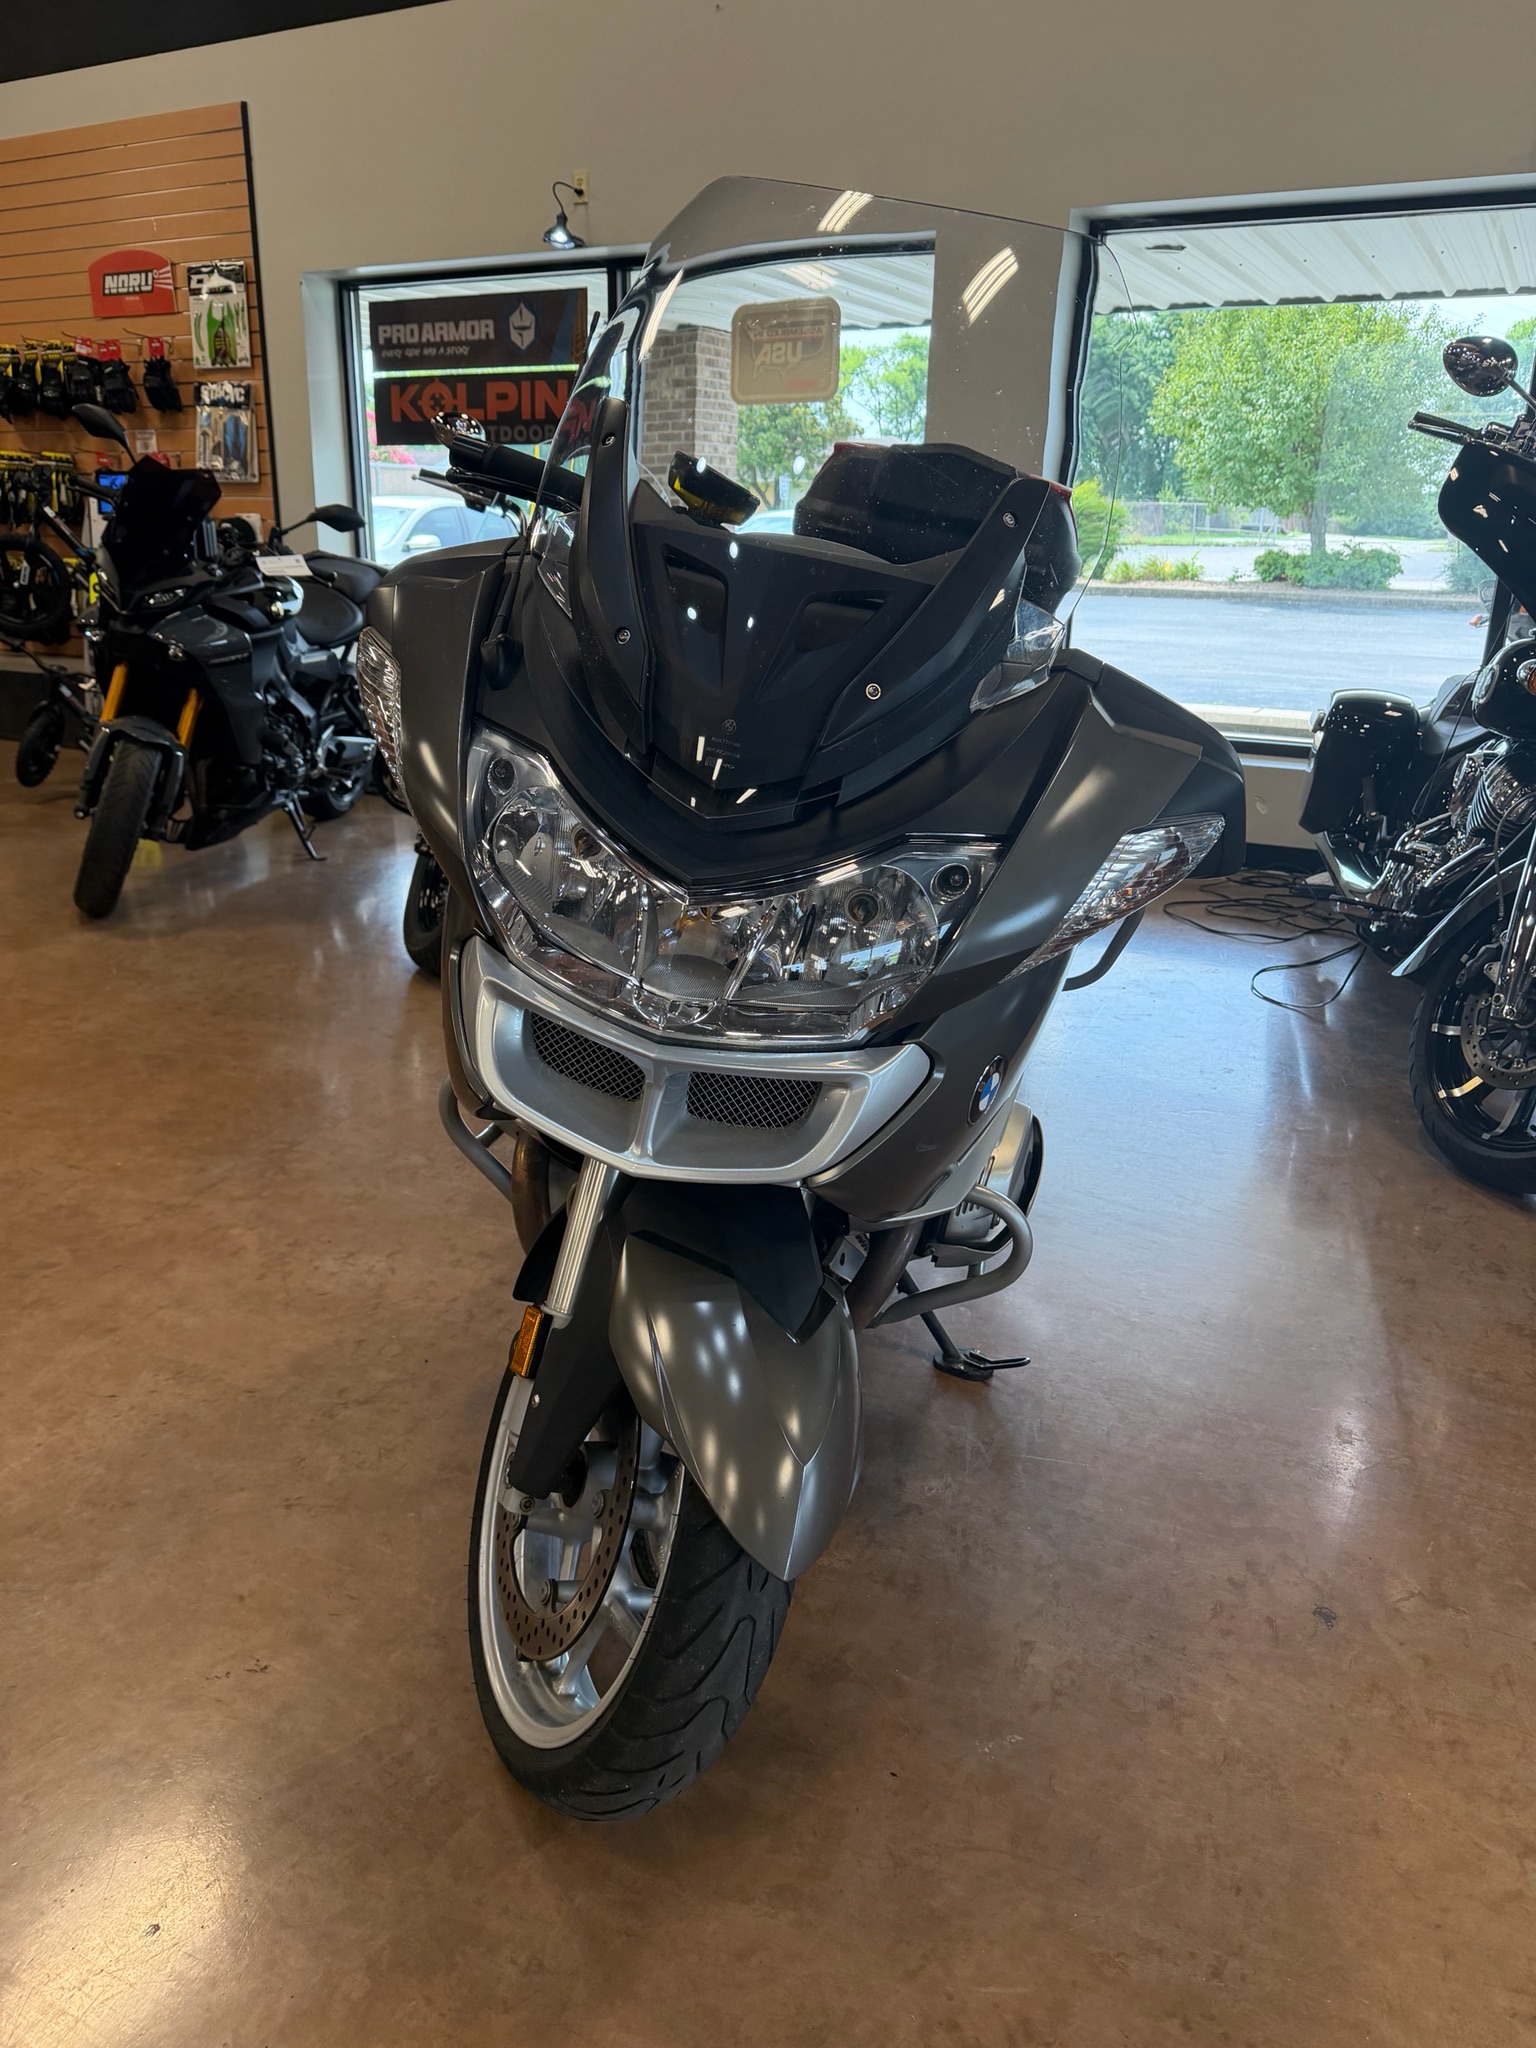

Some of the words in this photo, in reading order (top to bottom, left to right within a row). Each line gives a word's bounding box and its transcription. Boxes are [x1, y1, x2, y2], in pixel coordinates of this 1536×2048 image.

[104, 271, 153, 295] NORU
[390, 378, 570, 423] KOLPIN
[486, 424, 557, 443] TDOOR
